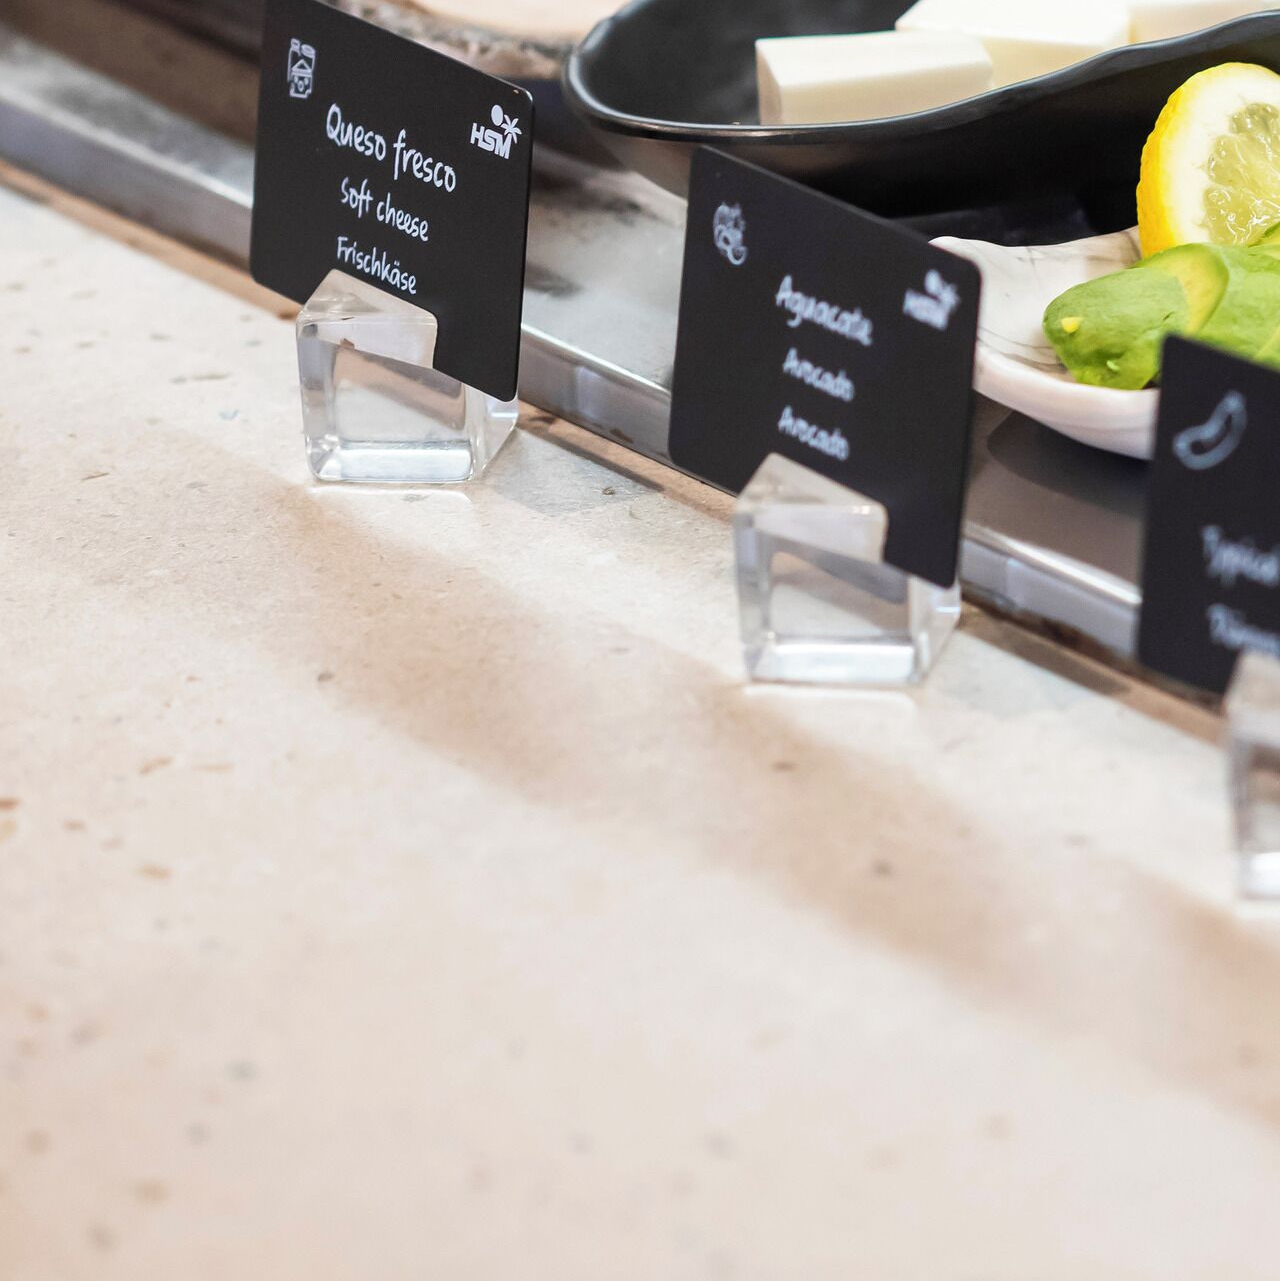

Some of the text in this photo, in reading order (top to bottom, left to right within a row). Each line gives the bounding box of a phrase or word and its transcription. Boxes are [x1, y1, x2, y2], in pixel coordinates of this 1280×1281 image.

[325, 102, 457, 194] Queso fresco
[470, 122, 513, 160] HSM
[376, 192, 429, 242] cheese
[336, 235, 417, 295] Frischkäse
[775, 273, 874, 347] Aguacate
[781, 346, 856, 403] Avocado
[776, 404, 850, 462] Avocado
